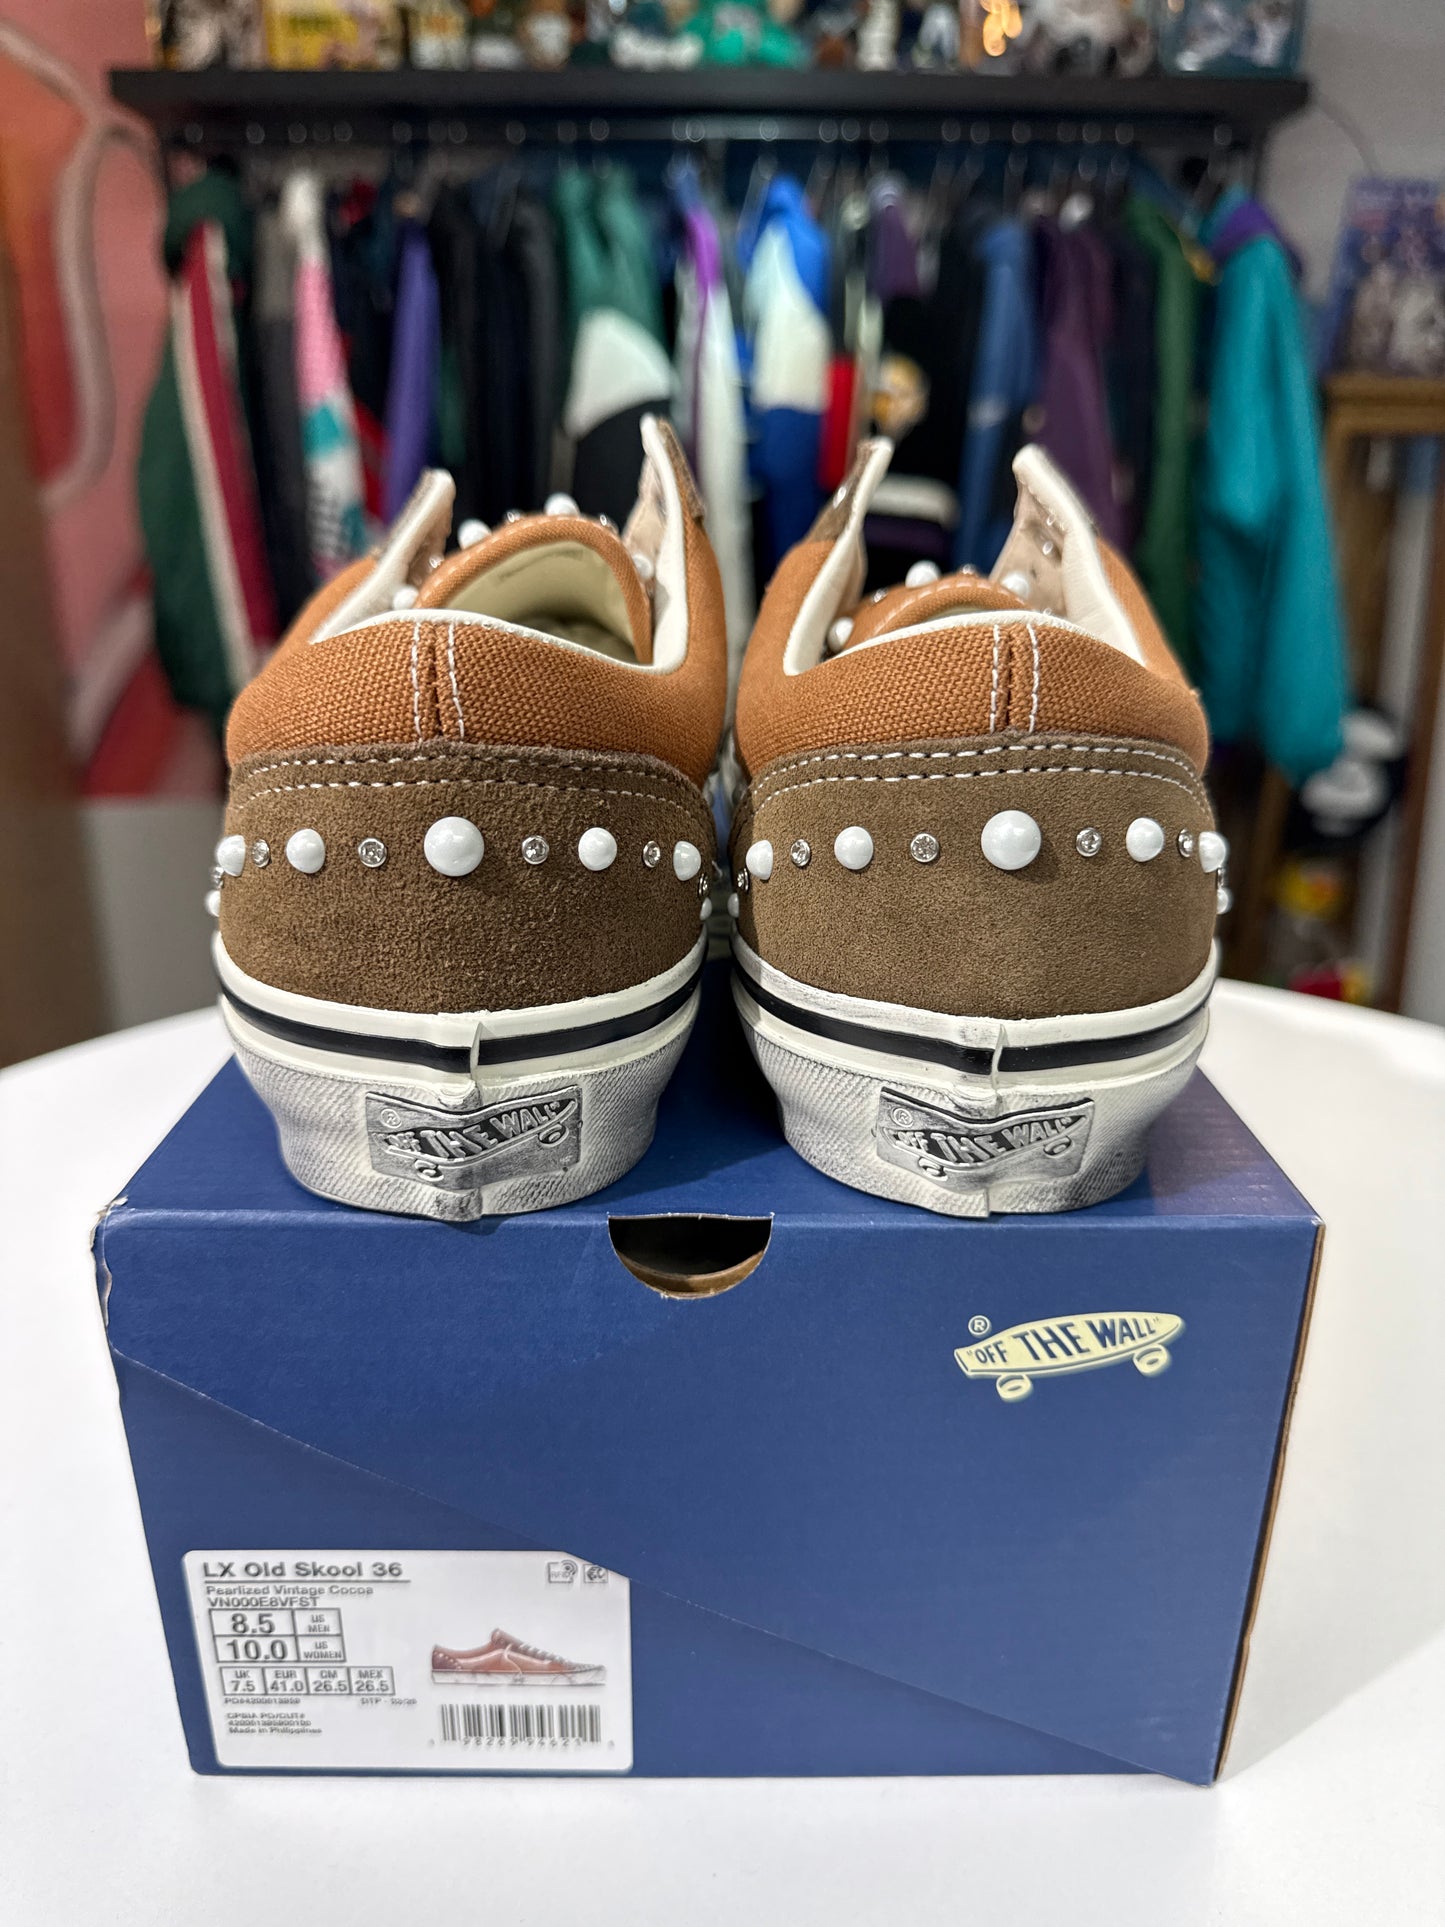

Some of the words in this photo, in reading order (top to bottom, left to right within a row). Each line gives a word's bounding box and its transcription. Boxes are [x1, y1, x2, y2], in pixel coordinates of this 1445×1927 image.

[420, 1124, 498, 1159] THE
[930, 1132, 1006, 1164] THE
[1012, 1322, 1091, 1361] THE
[203, 1562, 236, 1577] LX
[244, 1562, 286, 1578] Old
[295, 1561, 363, 1578] Skool
[372, 1562, 403, 1577] 36
[206, 1585, 270, 1596] Pearlized
[275, 1585, 325, 1597] Vintage
[329, 1585, 374, 1596] Cocoa
[231, 1612, 276, 1634] 8.5
[311, 1614, 325, 1624] US
[308, 1624, 330, 1633] MEN
[227, 1639, 289, 1660] 10.0
[315, 1640, 328, 1650] US
[304, 1650, 342, 1660] WOMEN
[235, 1669, 250, 1679] UK
[274, 1669, 297, 1679] EUR
[319, 1669, 338, 1679] CM
[358, 1669, 383, 1679] MEX
[231, 1680, 256, 1692] 7.5
[270, 1680, 304, 1692] 41.0
[313, 1680, 347, 1692] 26.5
[355, 1680, 389, 1692] 26.5
